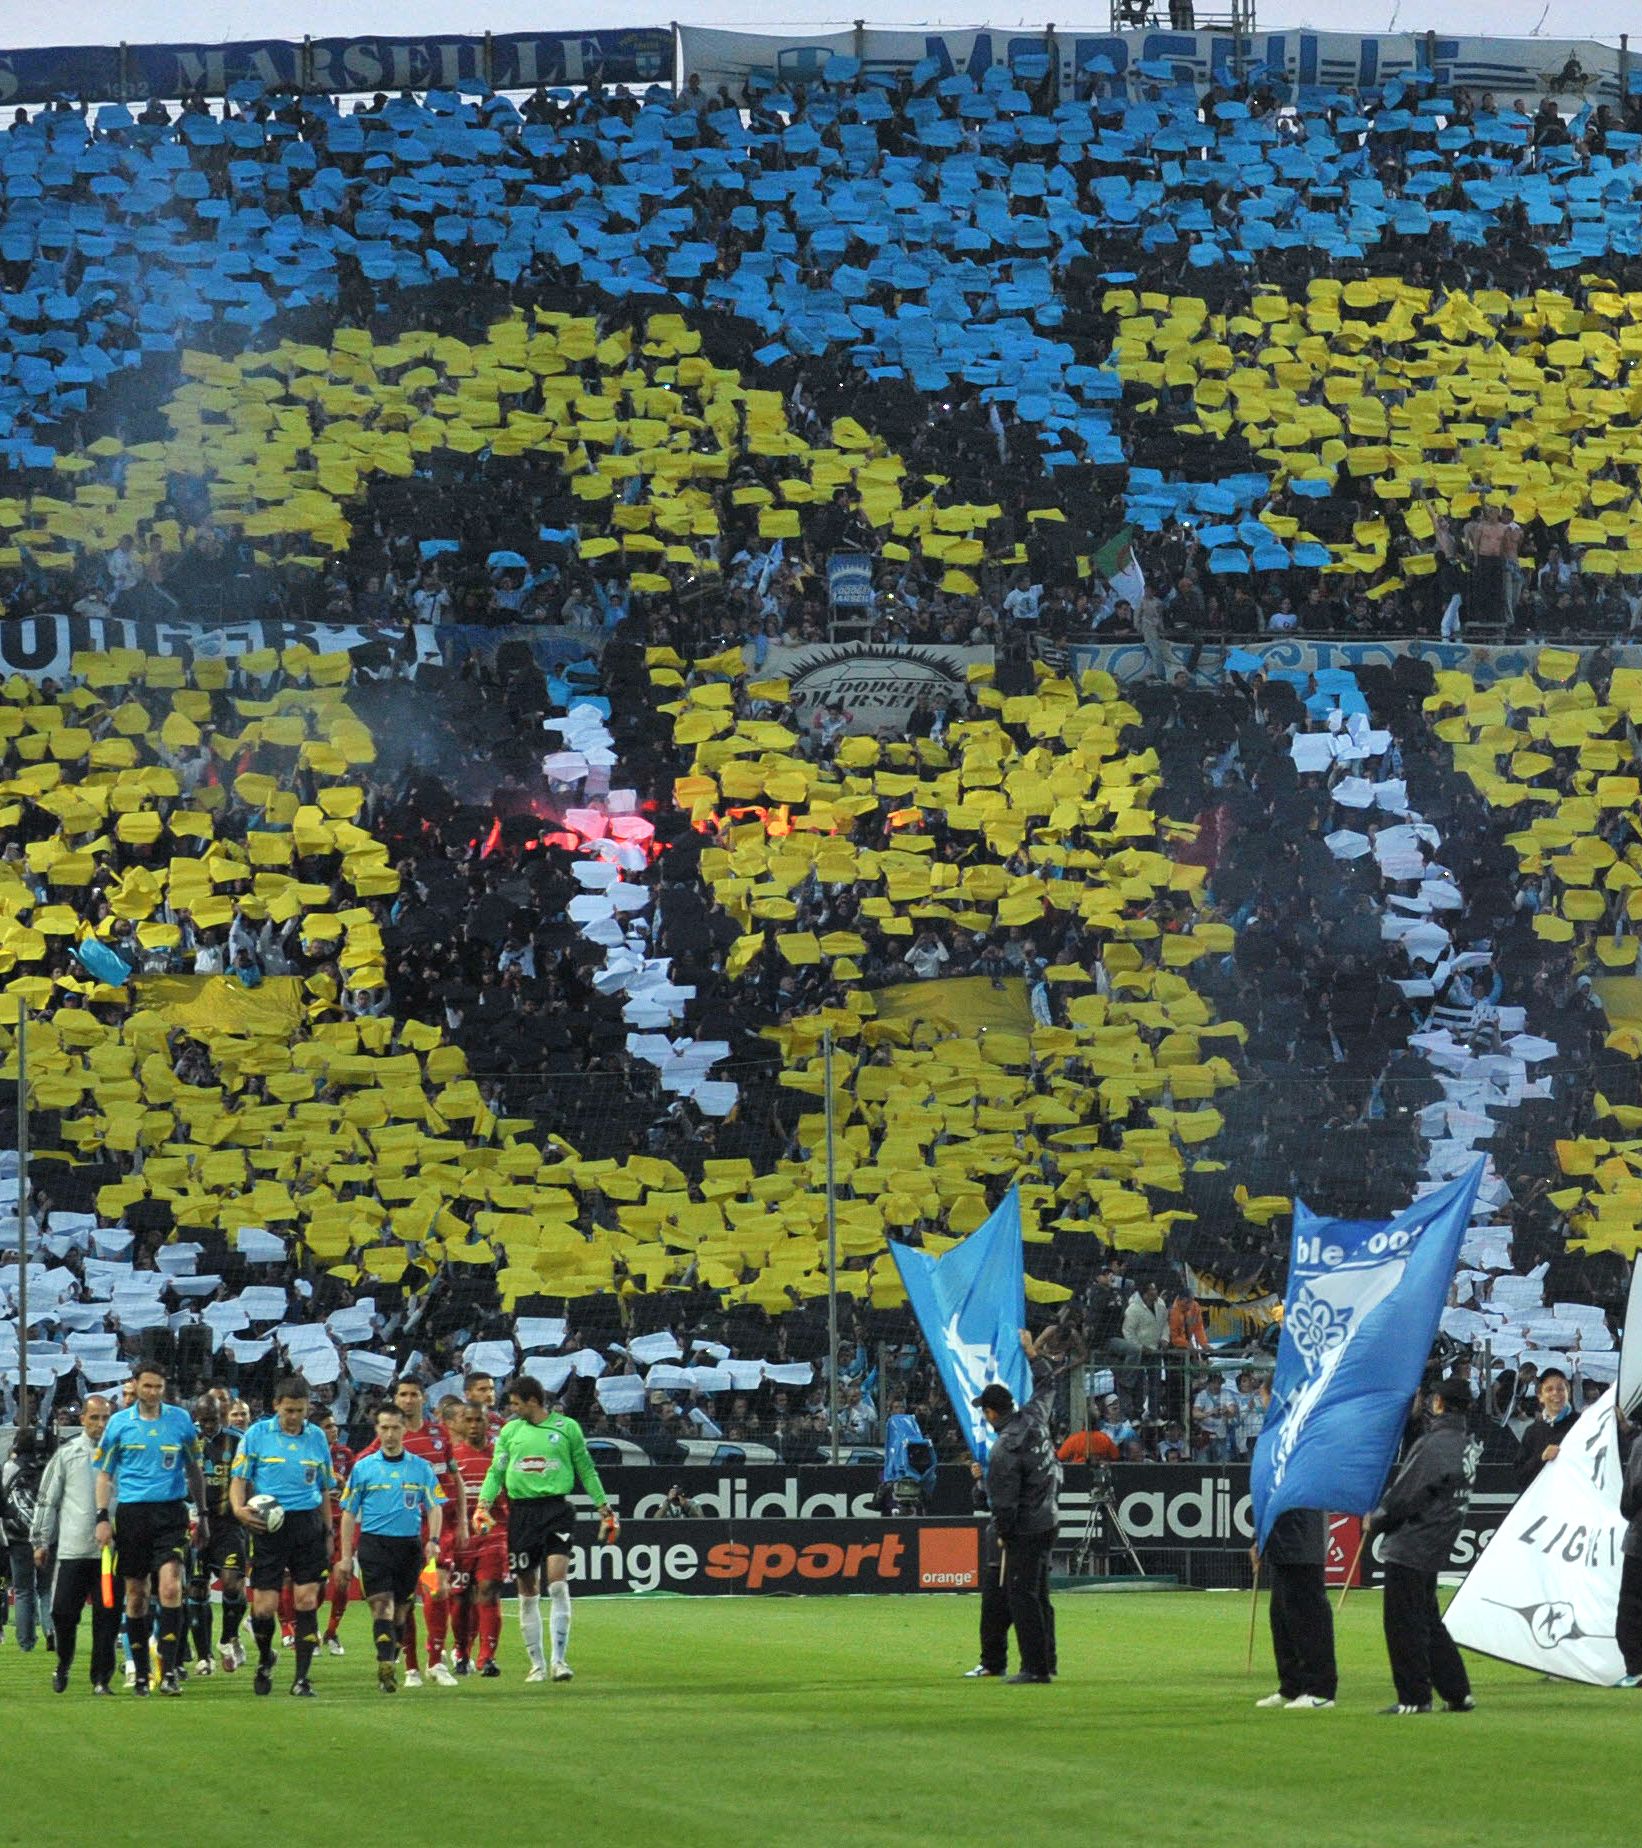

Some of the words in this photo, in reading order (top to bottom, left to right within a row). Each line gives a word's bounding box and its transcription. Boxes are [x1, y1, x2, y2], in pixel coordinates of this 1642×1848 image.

[176, 37, 605, 95] MARSEILLE
[1296, 1235, 1345, 1266] ble
[508, 1551, 528, 1569] 30
[704, 1533, 904, 1588] sport
[922, 1570, 972, 1586] orange
